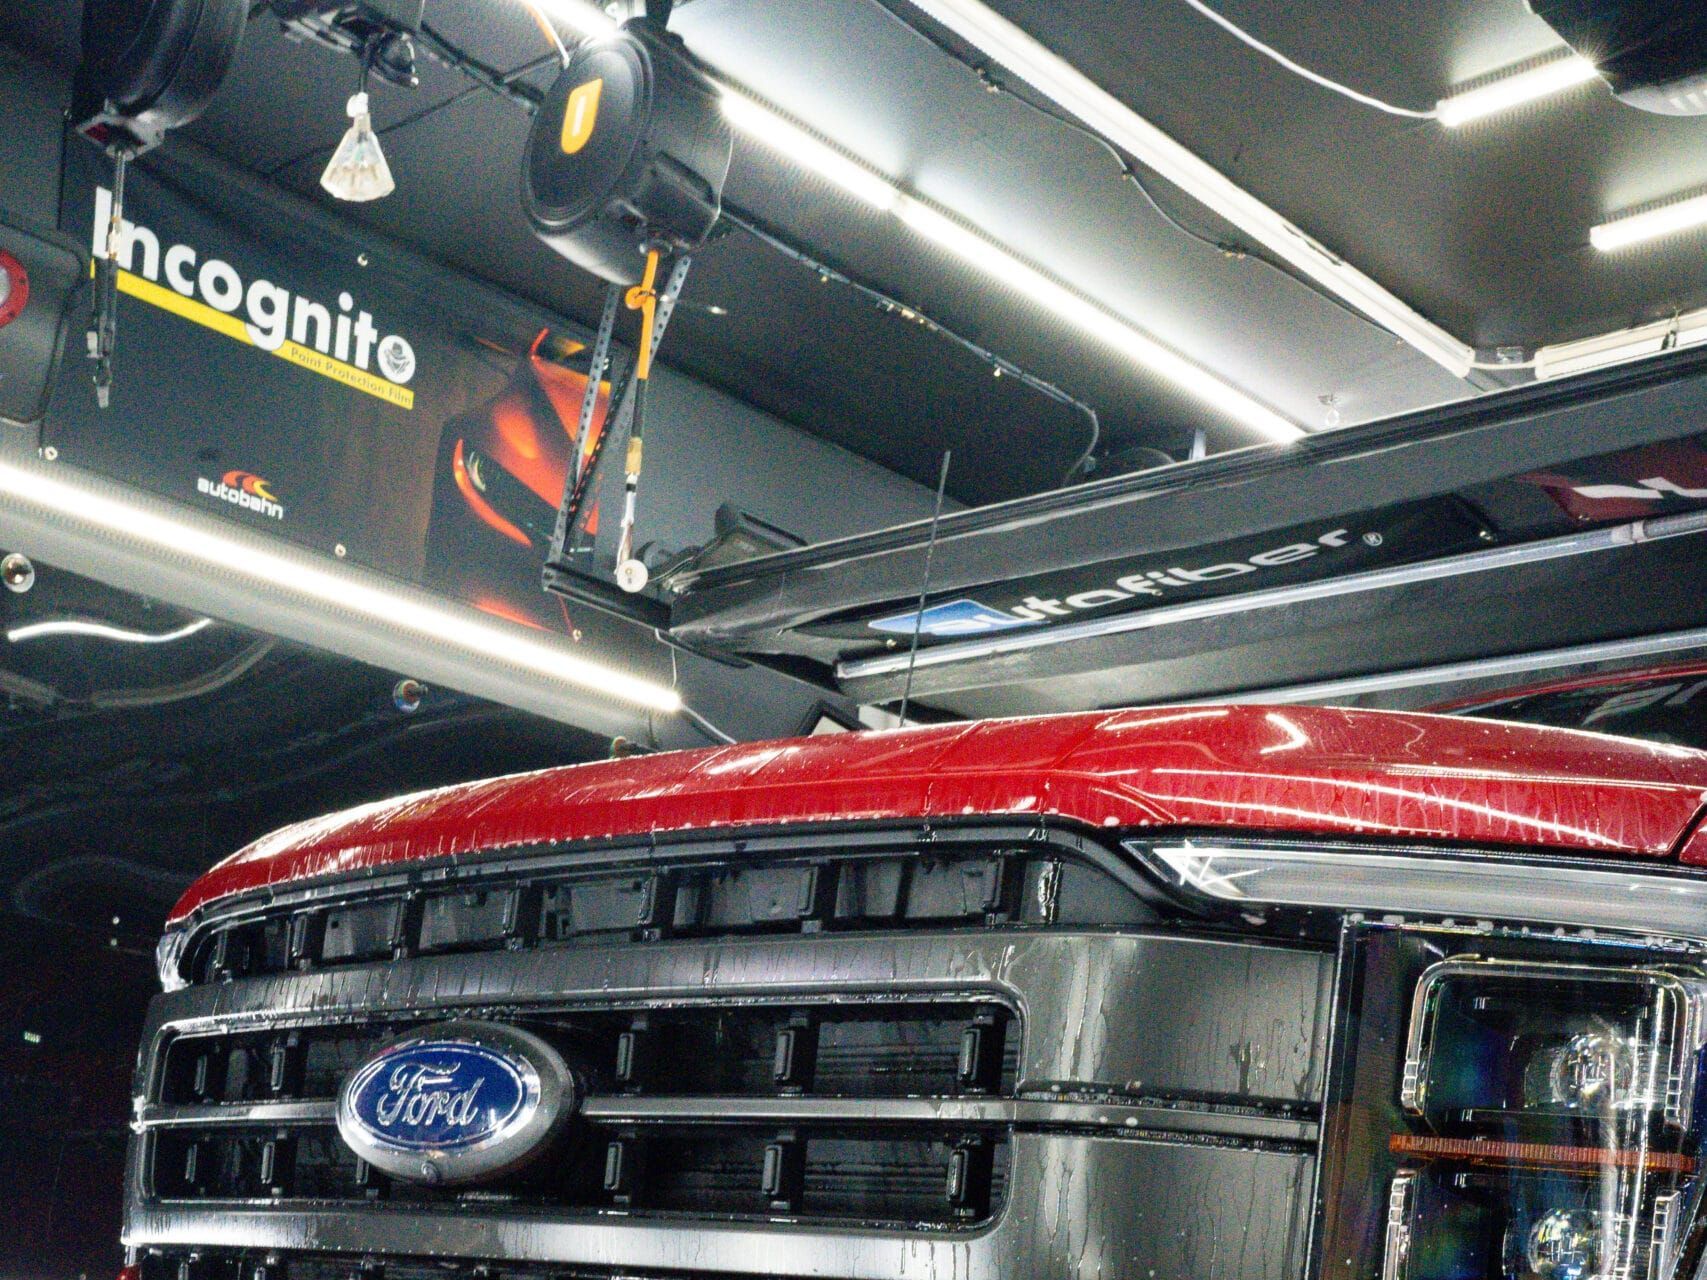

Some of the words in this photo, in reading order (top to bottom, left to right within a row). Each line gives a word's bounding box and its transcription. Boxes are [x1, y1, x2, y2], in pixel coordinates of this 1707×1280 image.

[92, 187, 416, 384] Incognito
[290, 346, 322, 368] Paint
[326, 361, 386, 394] Protection
[388, 384, 412, 405] Film
[197, 477, 284, 521] autobahn
[376, 1061, 486, 1127] Ford
